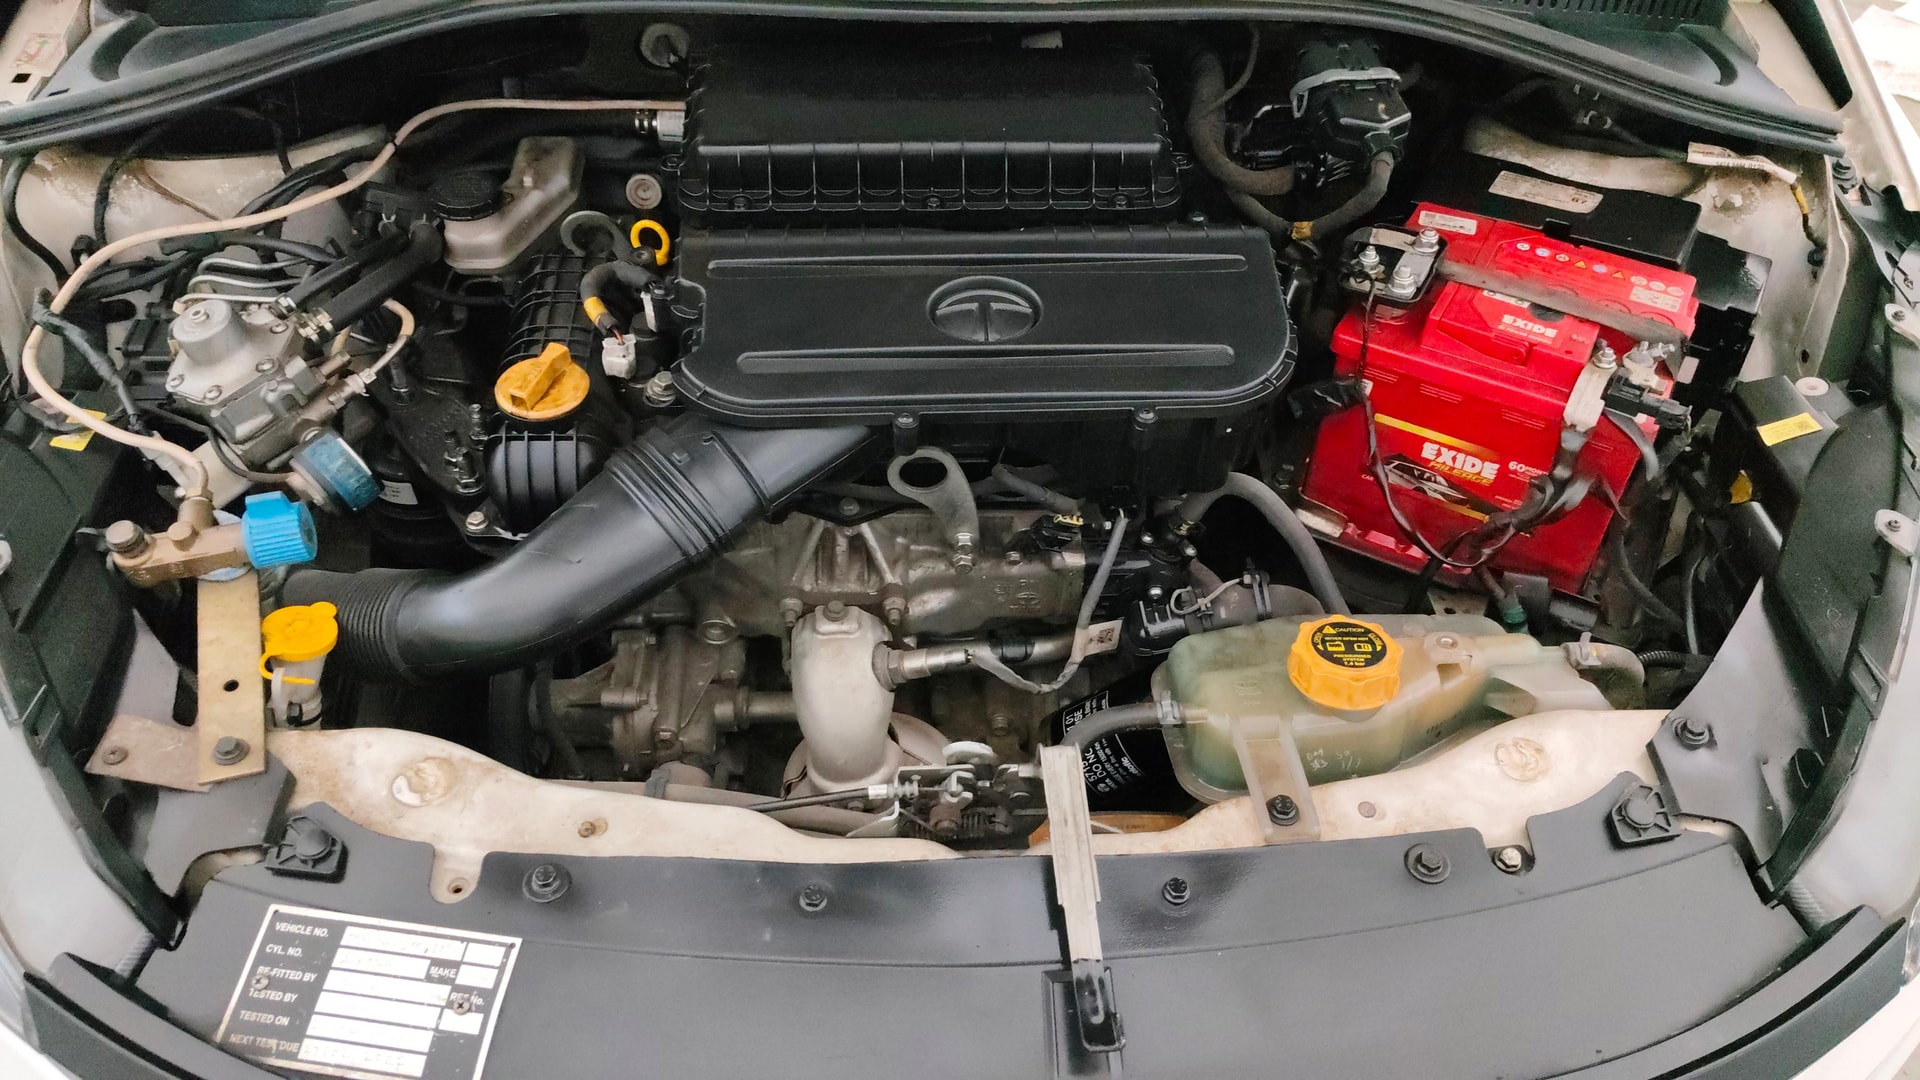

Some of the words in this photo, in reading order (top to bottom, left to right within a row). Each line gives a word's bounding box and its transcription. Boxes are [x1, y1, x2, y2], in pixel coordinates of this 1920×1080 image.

[1502, 314, 1558, 338] EXIDE
[1421, 441, 1500, 480] EXIDE
[1508, 461, 1526, 472] 60
[1428, 460, 1494, 487] MILEAGE
[1092, 763, 1107, 778] DO
[275, 922, 312, 936] VEHICLE
[313, 927, 329, 937] NO.
[286, 947, 303, 958] NO.
[303, 973, 318, 983] BY
[429, 966, 457, 978] MAKE
[248, 989, 285, 1001] TESTED
[284, 993, 298, 1003] BY
[239, 1010, 275, 1023] TESTED
[275, 1016, 290, 1026] ON
[229, 1033, 255, 1045] NEXT
[279, 1040, 300, 1053] DUE
